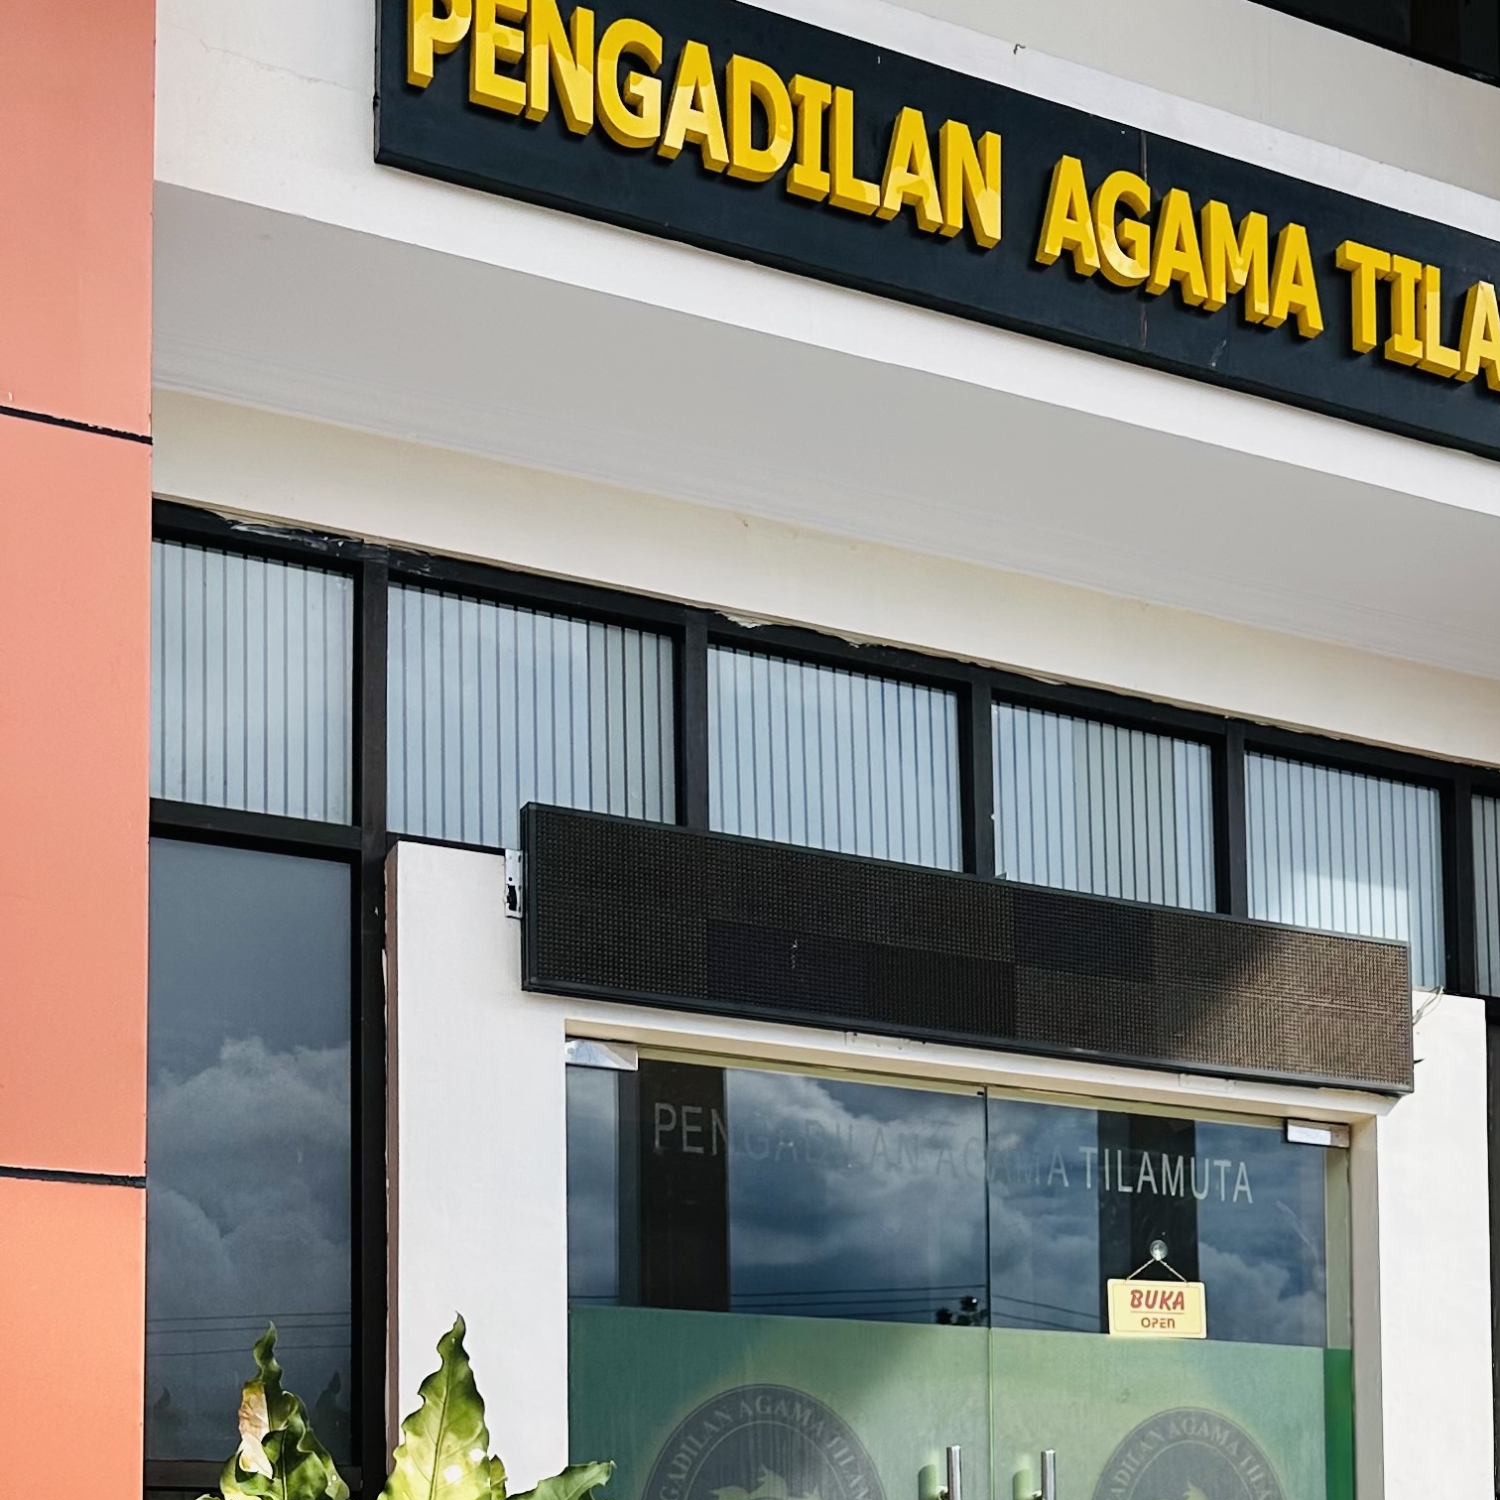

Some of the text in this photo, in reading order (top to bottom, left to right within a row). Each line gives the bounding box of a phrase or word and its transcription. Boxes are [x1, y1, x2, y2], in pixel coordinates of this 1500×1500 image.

[407, 0, 1001, 249] PENGADILAN
[1035, 154, 1324, 339] AGAMA
[1078, 1145, 1253, 1204] TILAMUTA
[1130, 1289, 1185, 1311] BUKA
[1141, 1317, 1175, 1329] OPEN
[739, 1394, 827, 1436] AGAMA
[1169, 1416, 1242, 1456] AGAMA
